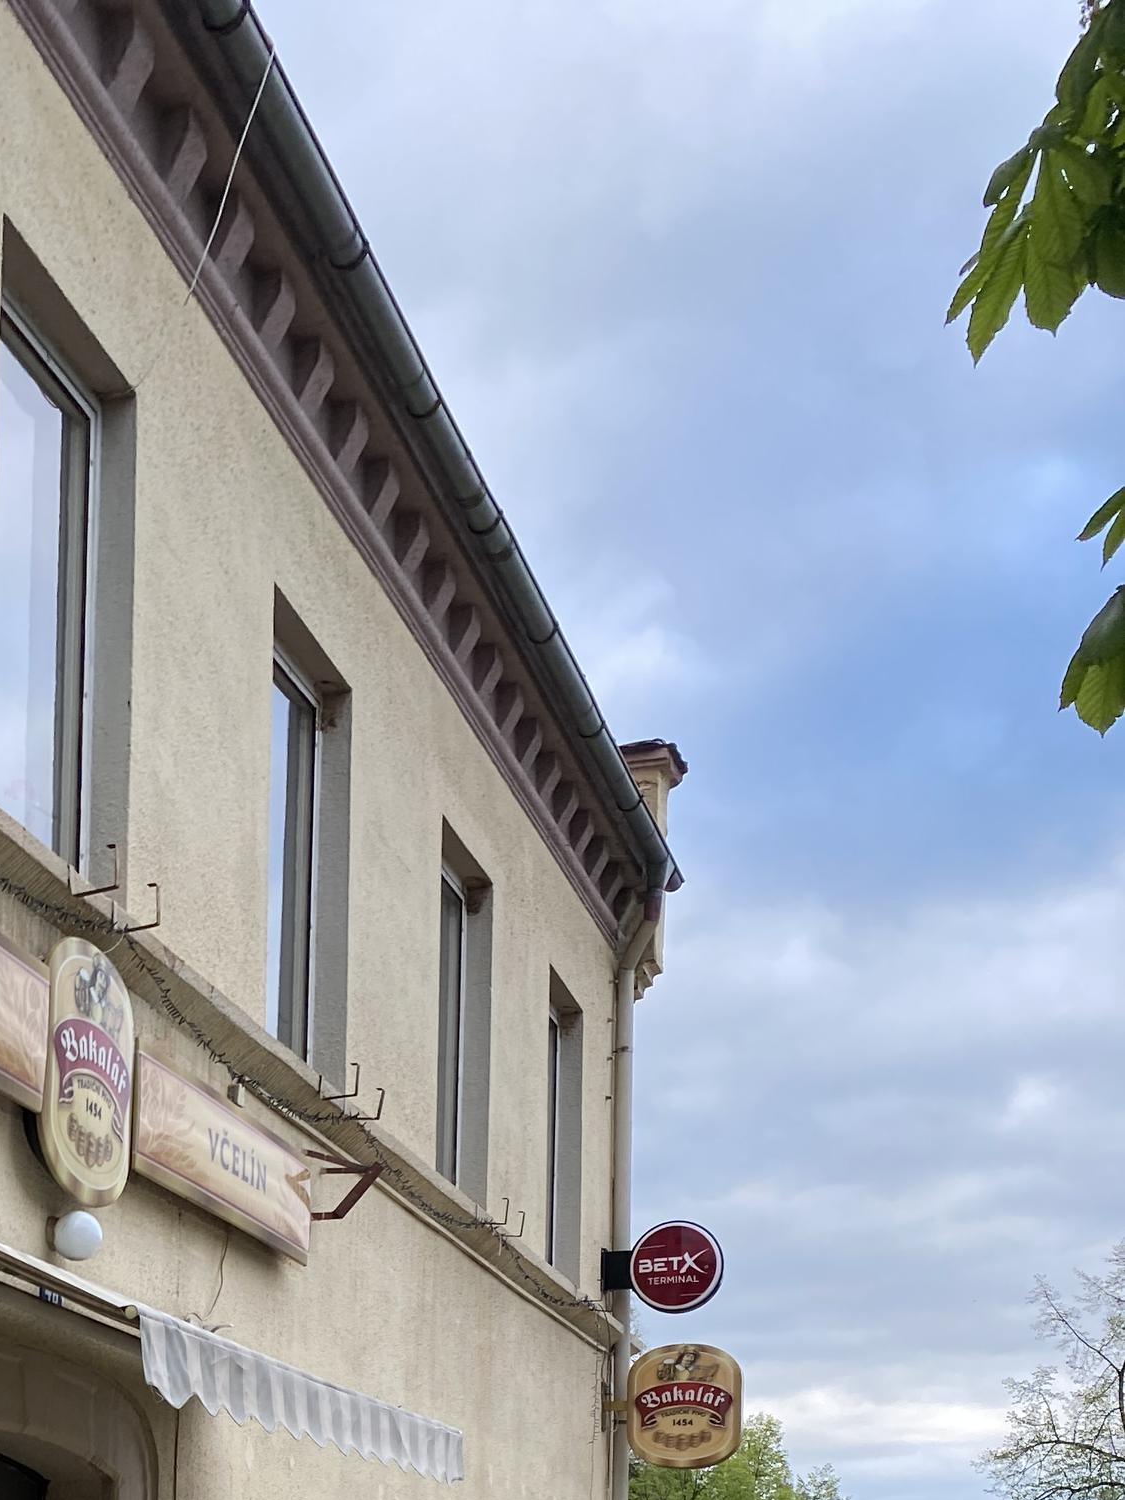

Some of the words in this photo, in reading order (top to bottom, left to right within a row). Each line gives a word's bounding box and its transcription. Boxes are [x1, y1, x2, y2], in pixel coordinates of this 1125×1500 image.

[60, 1026, 126, 1094] Bakalář
[85, 1097, 102, 1121] 1454
[207, 1127, 267, 1195] VČELÍN
[638, 1247, 710, 1275] BETX
[647, 1274, 700, 1286] TERMINAL
[641, 1386, 725, 1408] Bakalář
[672, 1419, 694, 1427] 1454
